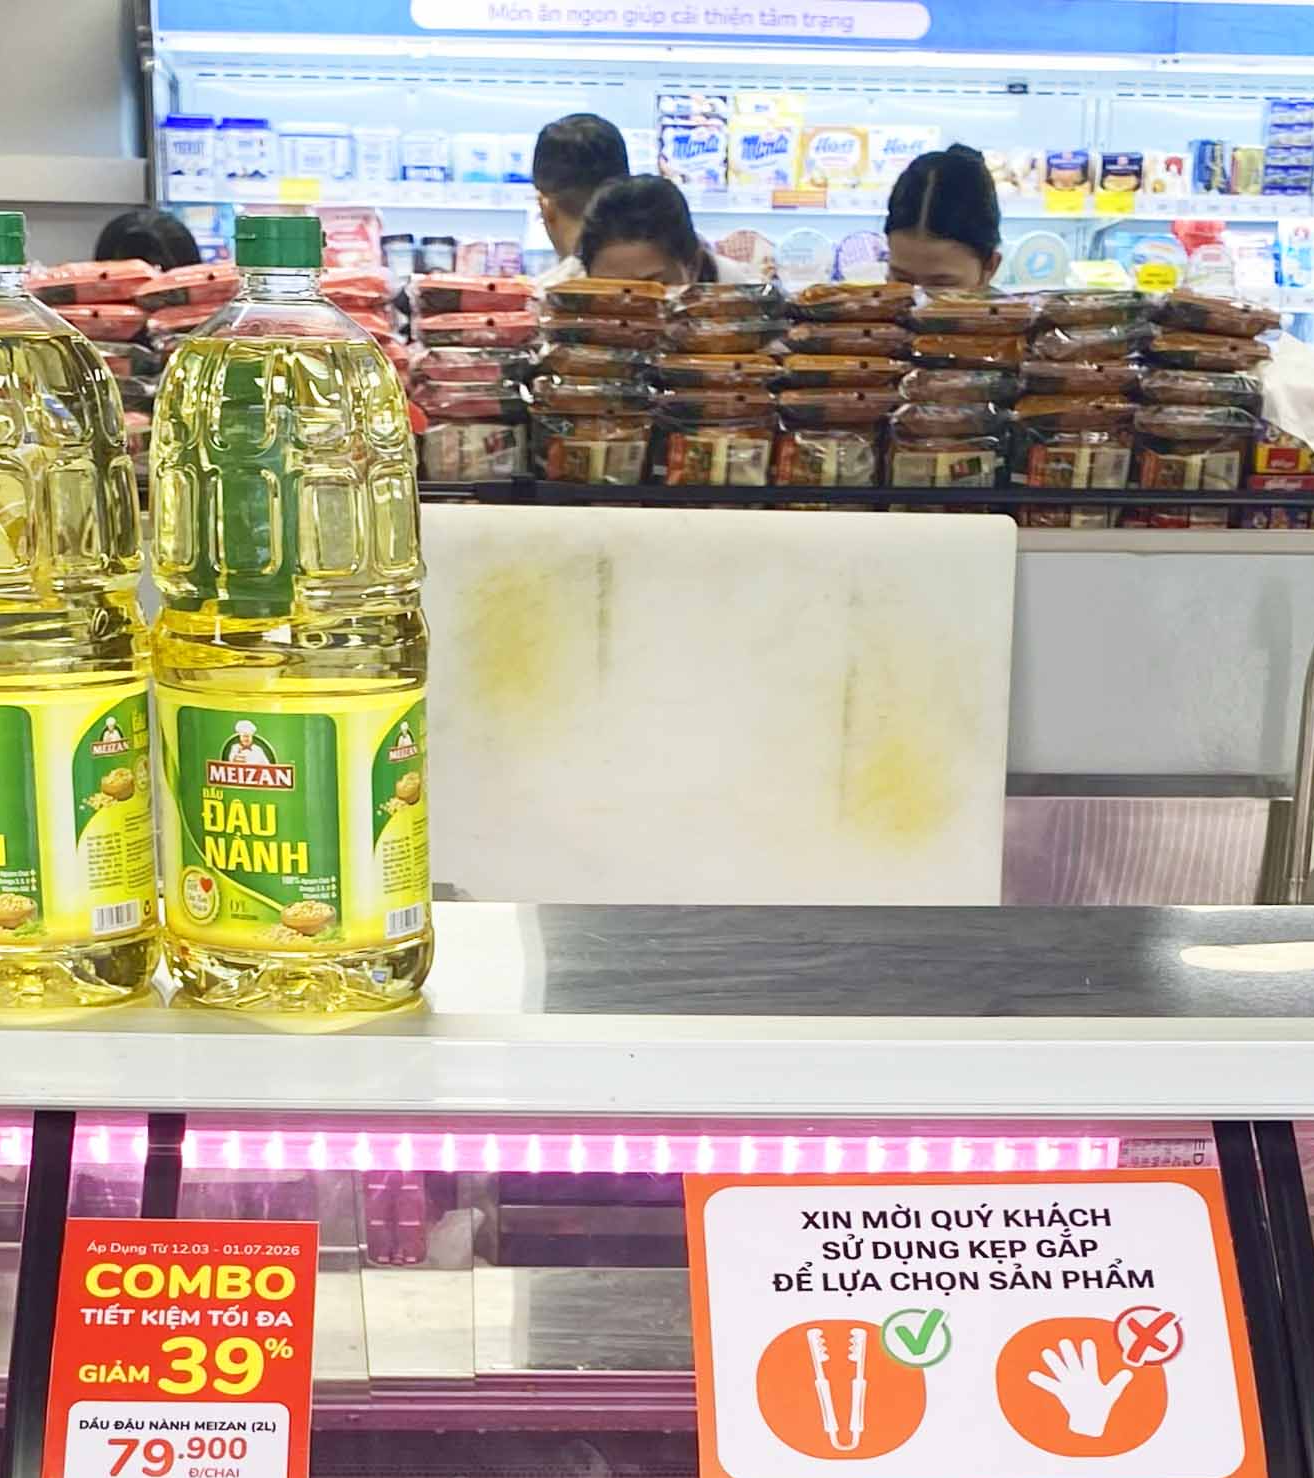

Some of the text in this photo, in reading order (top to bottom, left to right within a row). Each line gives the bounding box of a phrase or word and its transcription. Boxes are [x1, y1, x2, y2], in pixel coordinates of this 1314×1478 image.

[623, 4, 665, 27] giúp
[208, 763, 293, 787] MEIZAN
[204, 832, 309, 875] NÀNH
[801, 1200, 1111, 1232] XIN MỜI QUÝ KHÁCH
[87, 1240, 300, 1257] Áp Dụng Từ 12.03 01.07.2026
[822, 1226, 1098, 1266] SỬ DỤNG KẸP GẮP
[85, 1262, 296, 1301] COMBO
[772, 1258, 1154, 1298] ĐỂ LỰA CHỌN SẢN PHẨM
[80, 1302, 293, 1330] TIẾT KIỆM TỐI ĐA
[79, 1336, 294, 1396] GIẢM 39%
[79, 1417, 277, 1433] DẦU ĐẬU NÀNH MEIZAN (2L)
[107, 1436, 248, 1478] 79.900
[188, 1467, 240, 1478] Đ/CHAI
